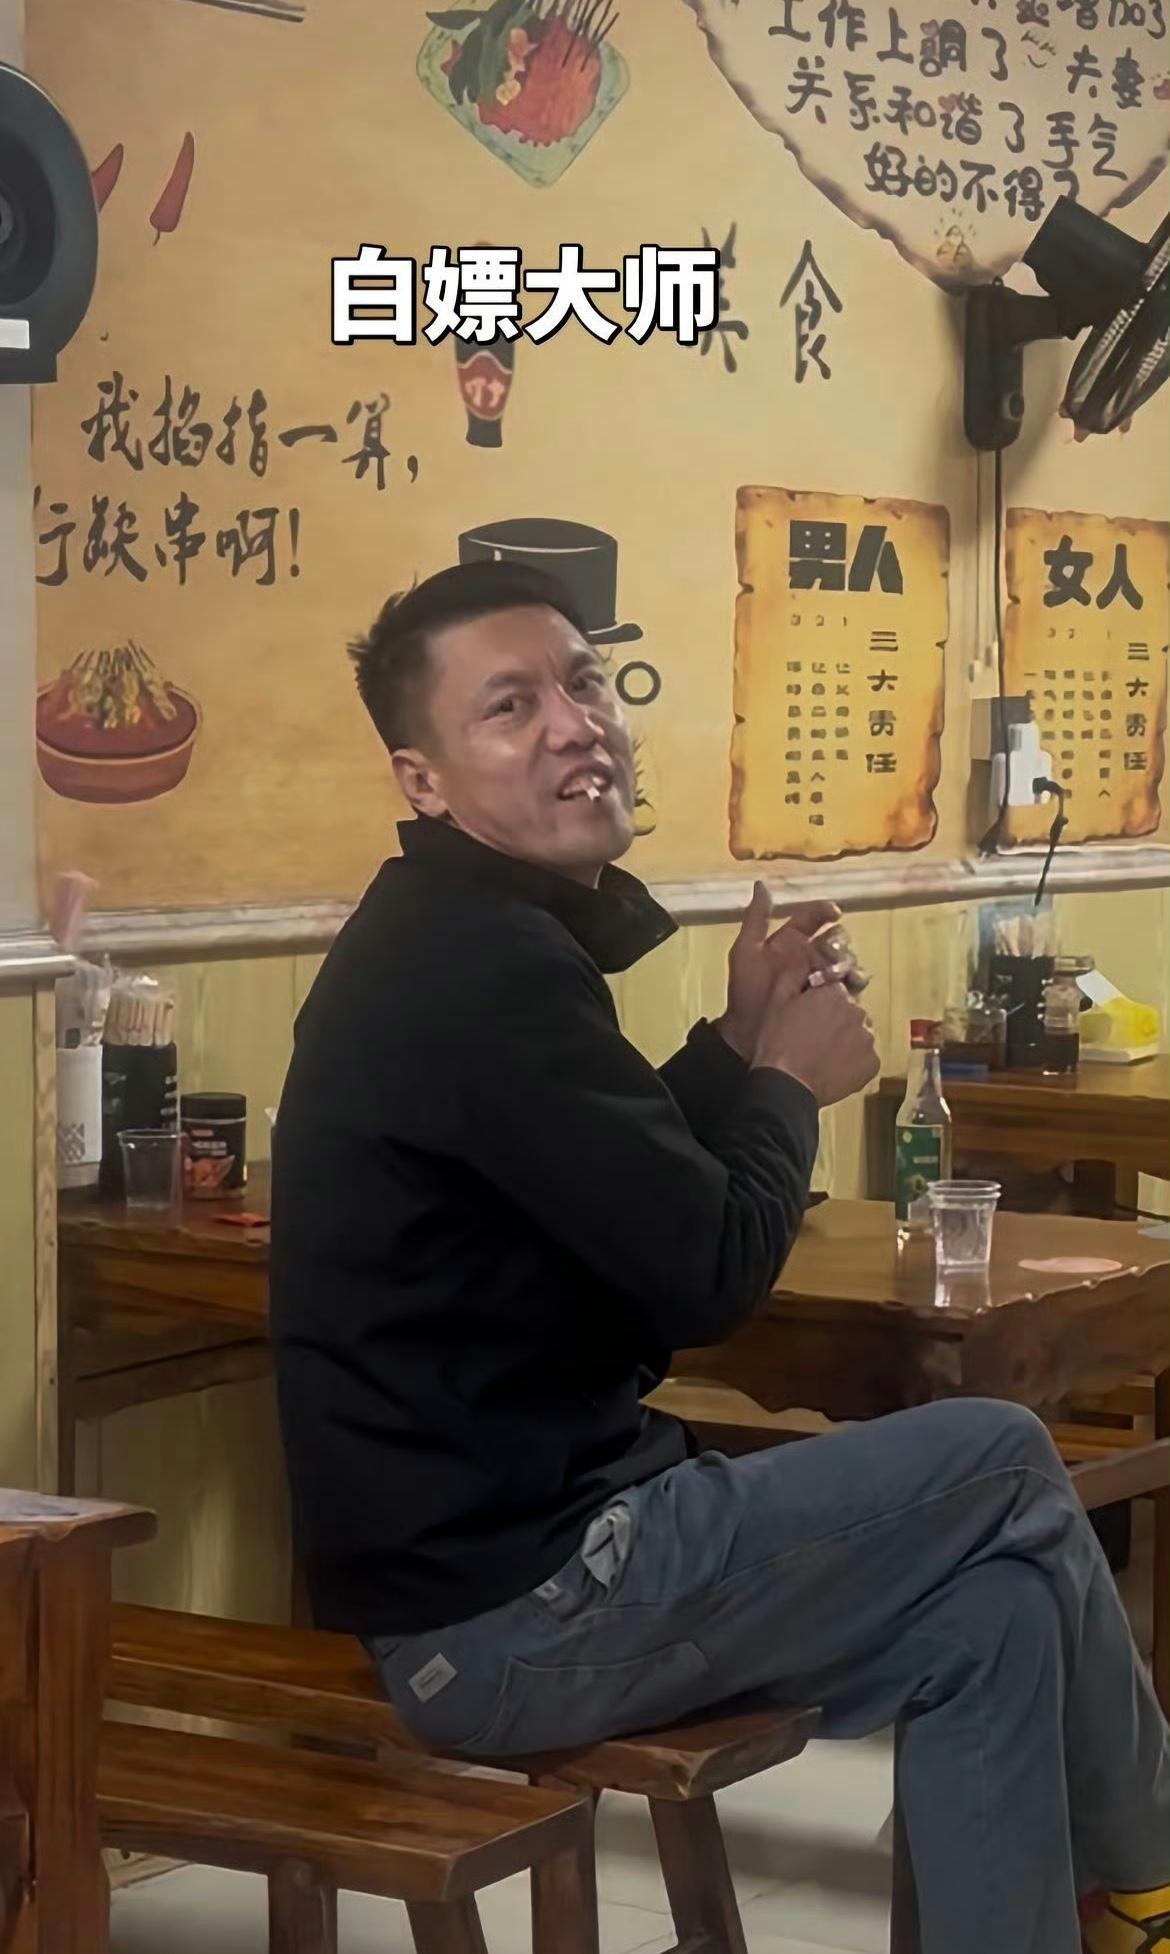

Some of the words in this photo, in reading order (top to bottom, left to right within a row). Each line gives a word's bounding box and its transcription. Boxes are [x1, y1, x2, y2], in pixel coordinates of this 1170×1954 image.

[1066, 44, 1145, 109] 夫妻
[789, 519, 903, 595] 男人
[1043, 534, 1144, 610] 女人
[865, 631, 899, 774] 三大责任
